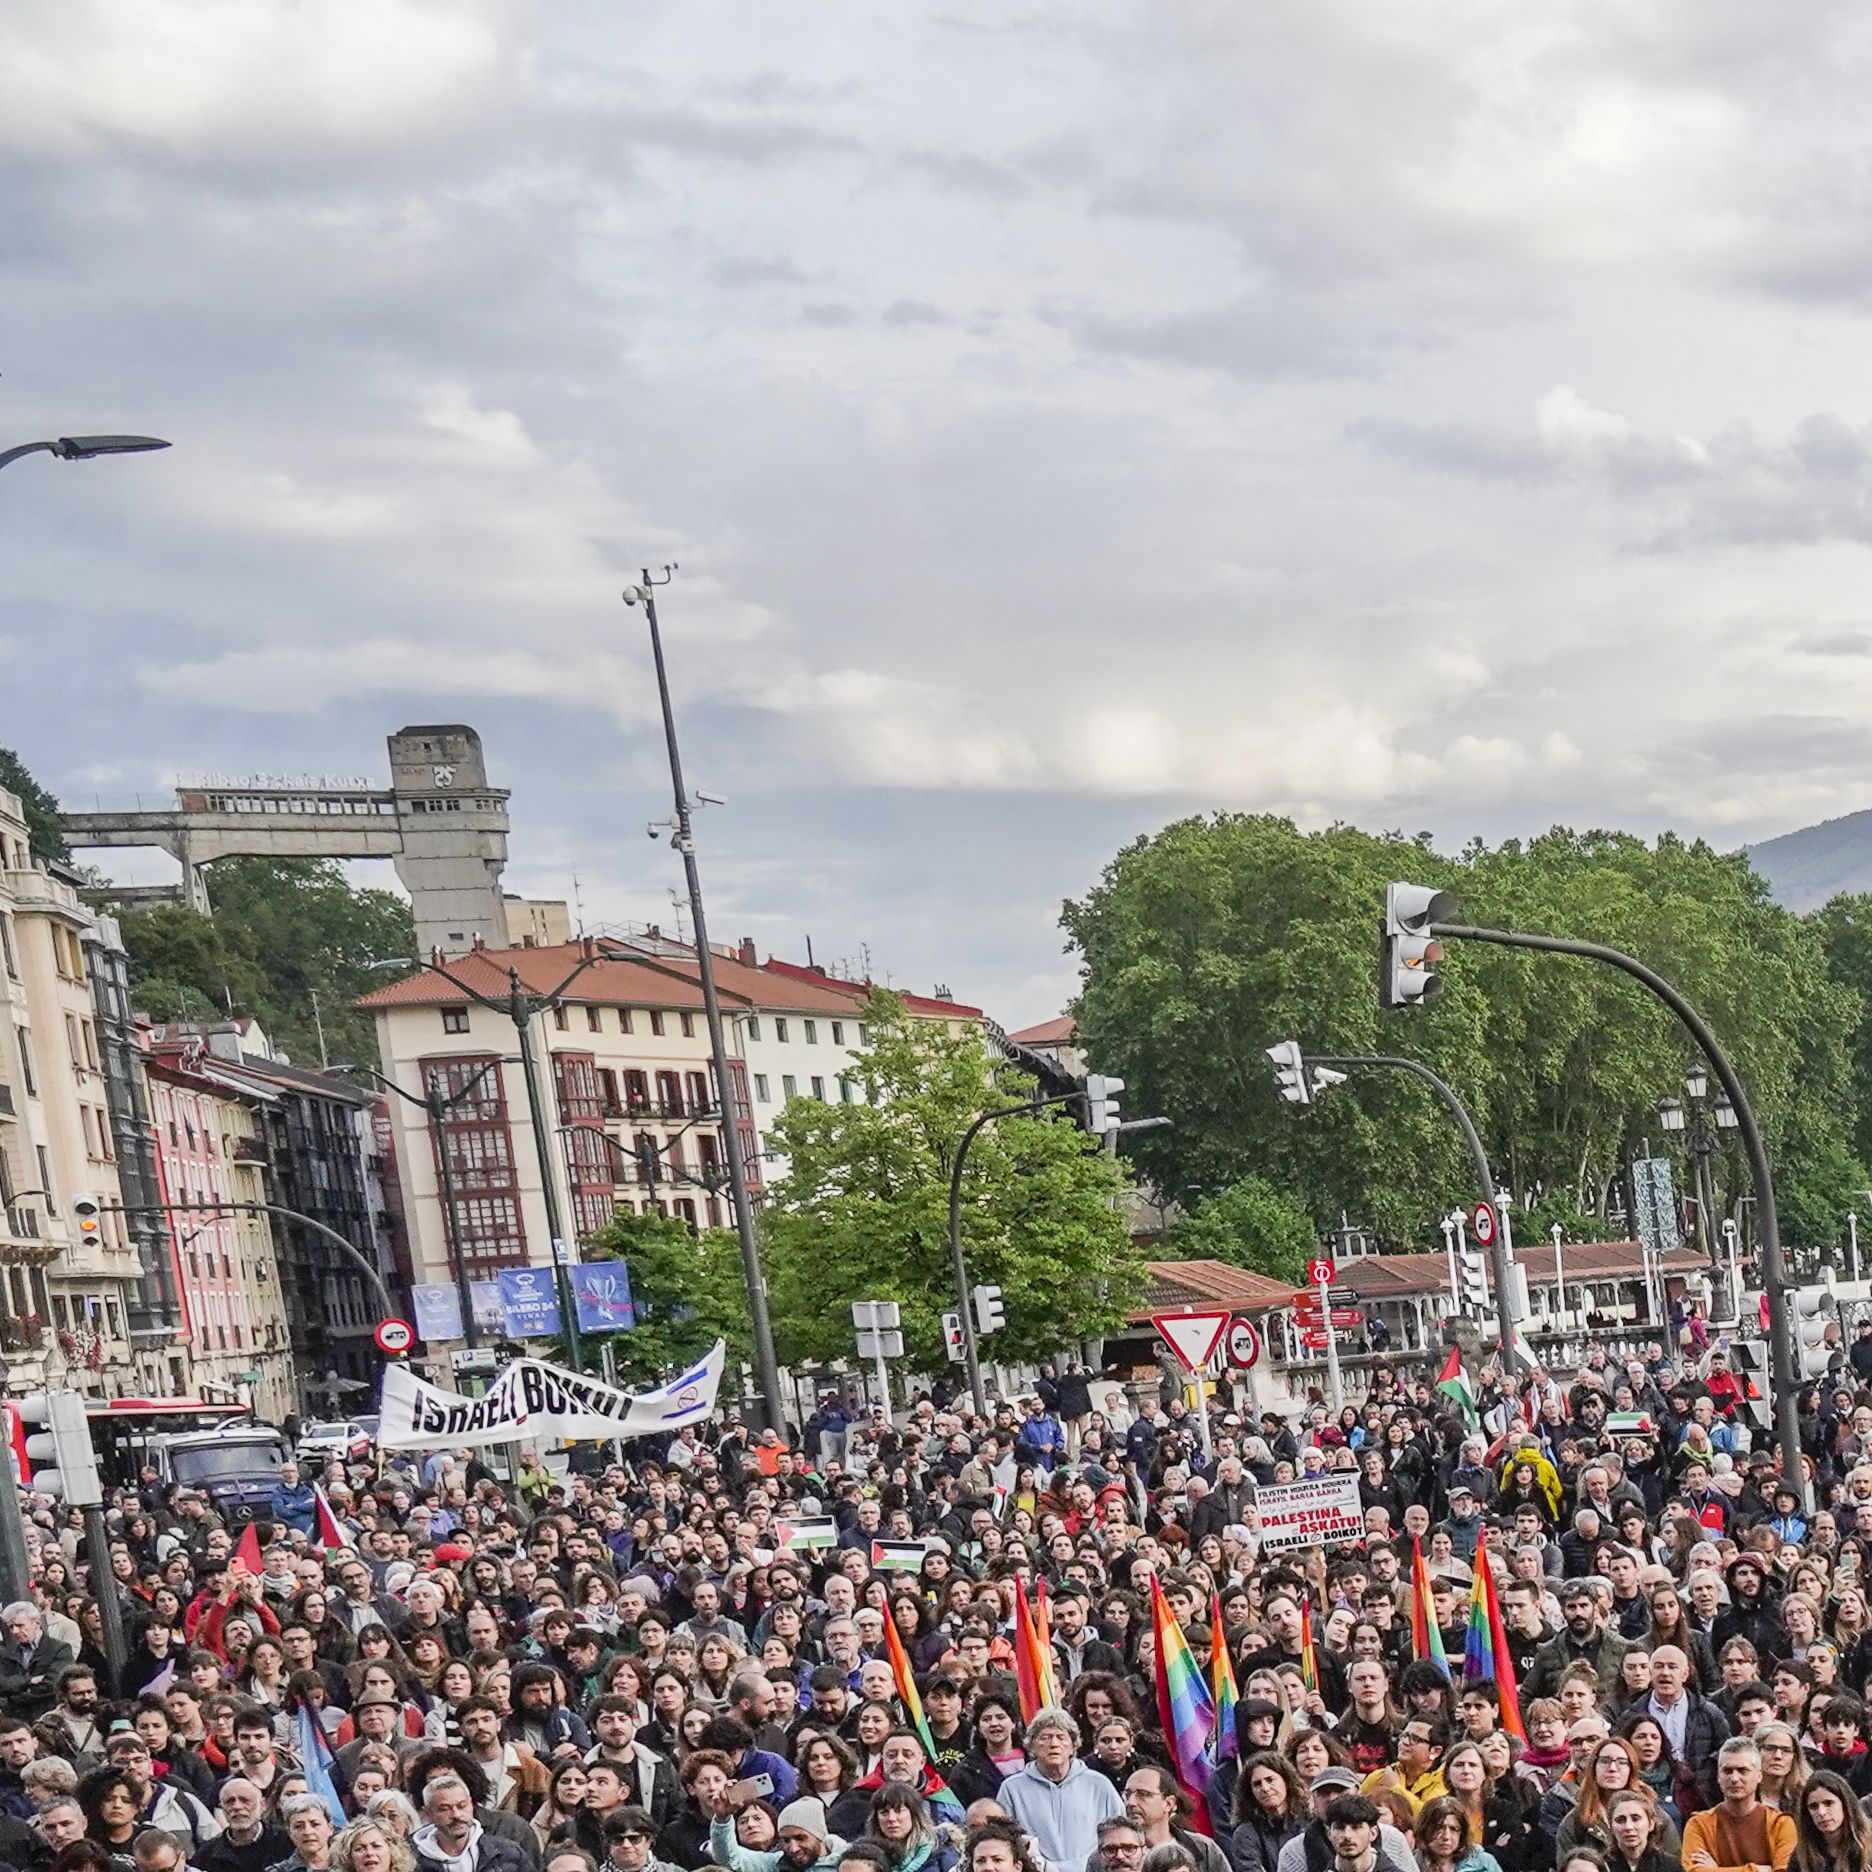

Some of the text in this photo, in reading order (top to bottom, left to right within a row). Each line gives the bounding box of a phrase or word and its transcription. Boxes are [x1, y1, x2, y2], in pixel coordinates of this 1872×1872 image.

[1261, 1506, 1341, 1528] PALESTINA
[1299, 1516, 1361, 1534] ASKATU!
[1265, 1527, 1363, 1549] ISRAELI BOIKOT
